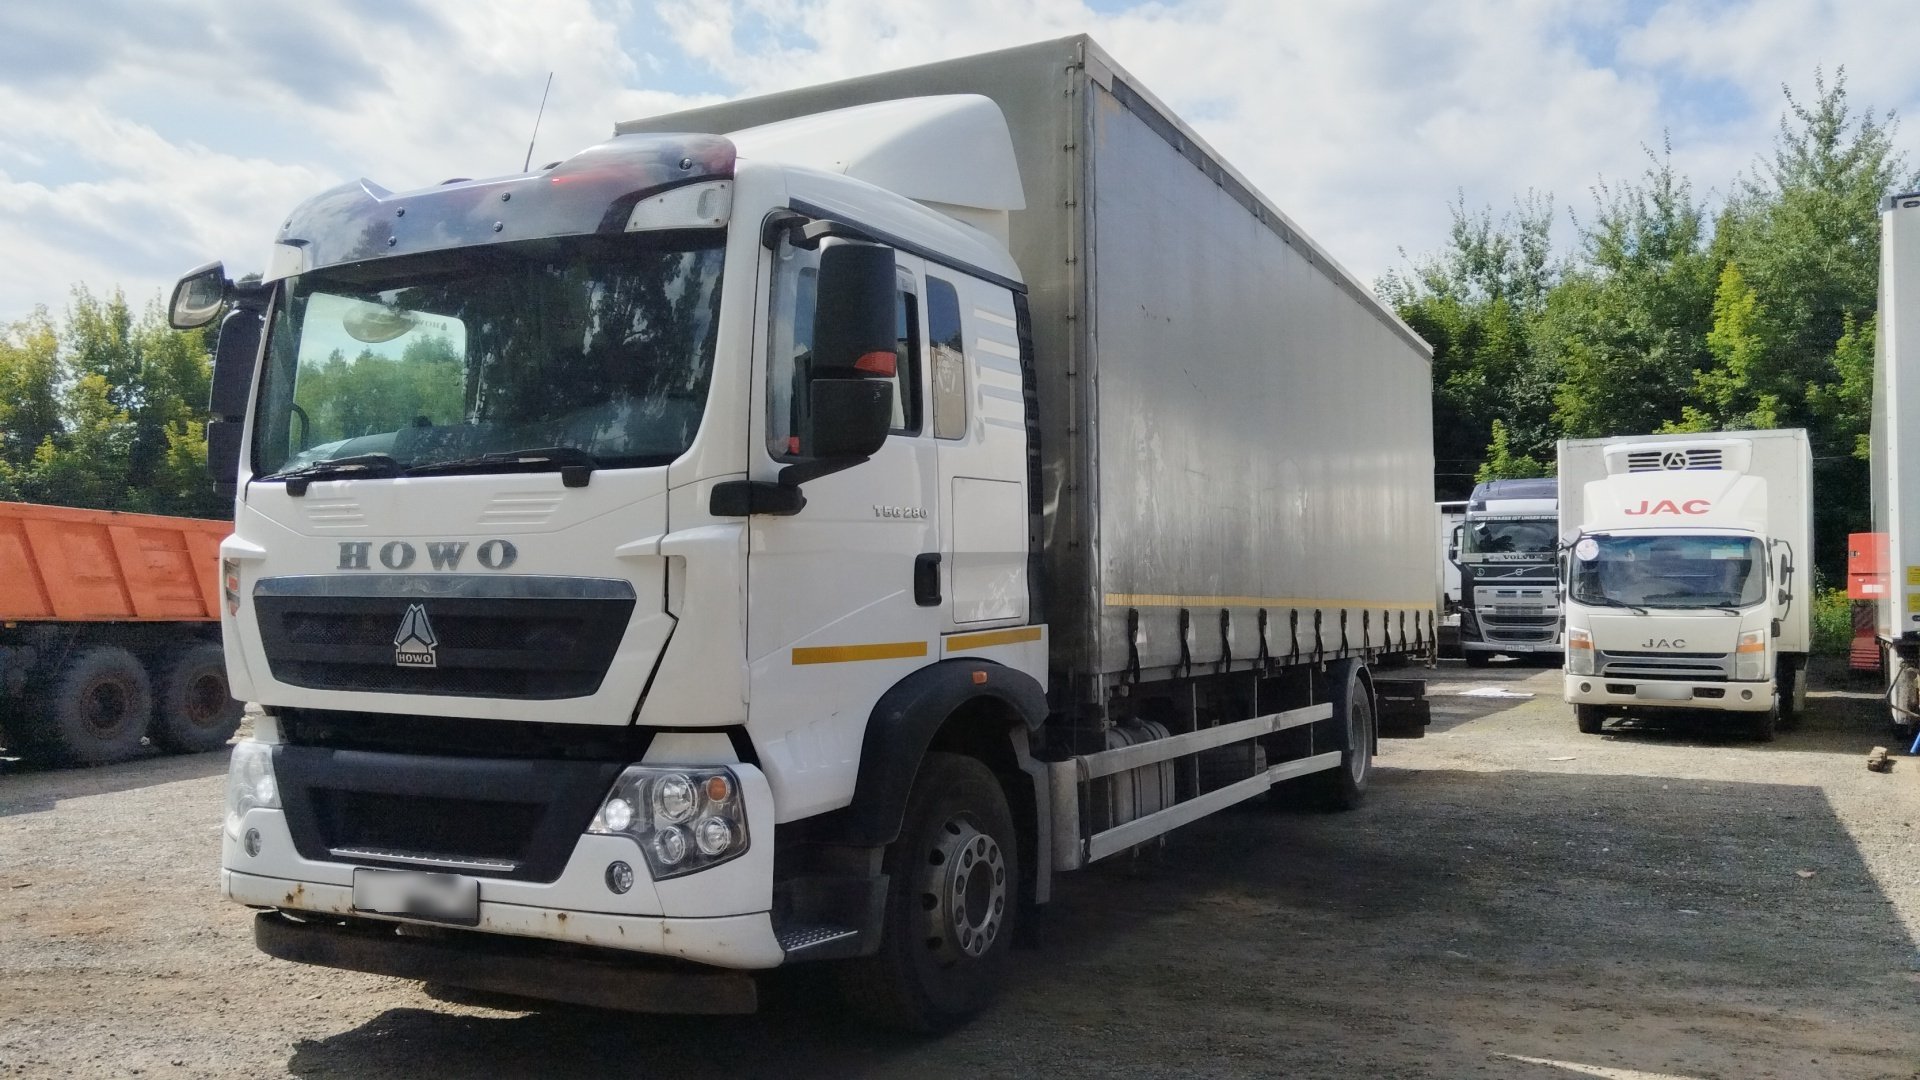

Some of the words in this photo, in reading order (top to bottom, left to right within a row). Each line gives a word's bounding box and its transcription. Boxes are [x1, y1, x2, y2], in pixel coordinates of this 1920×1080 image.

[903, 507, 928, 519] 280
[1624, 499, 1711, 515] JAC
[336, 539, 518, 571] HOWO
[1641, 638, 1686, 648] JAC
[398, 653, 432, 663] HOWO
